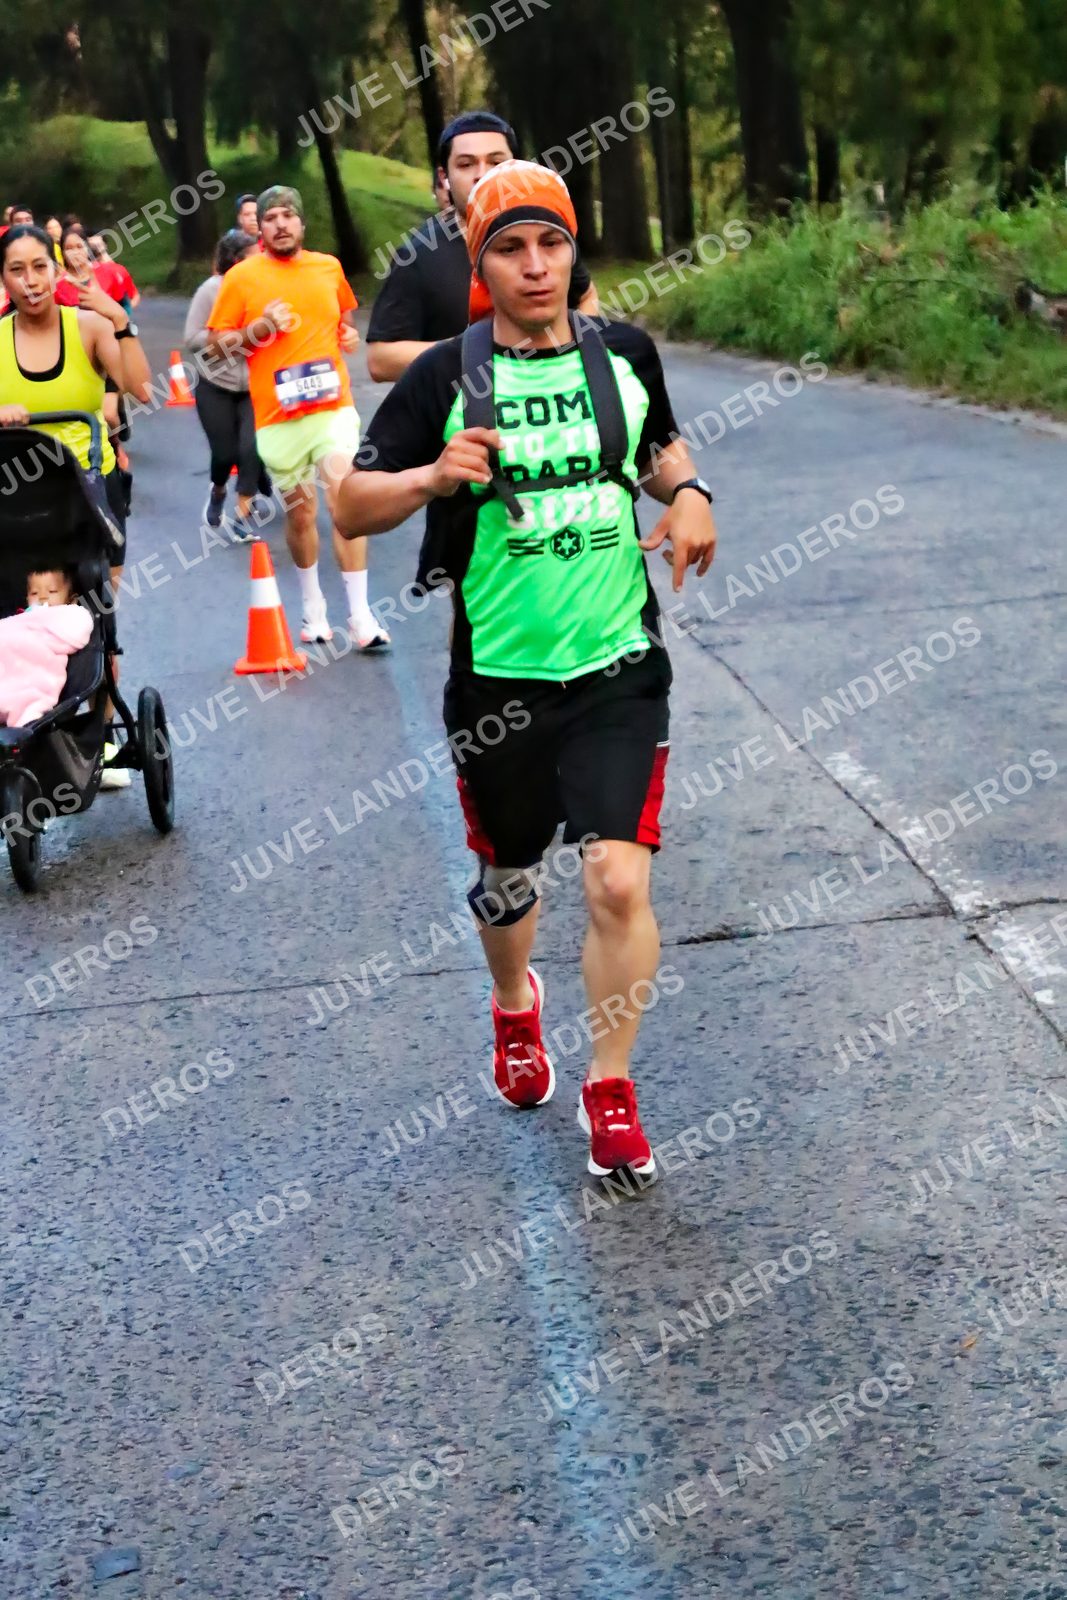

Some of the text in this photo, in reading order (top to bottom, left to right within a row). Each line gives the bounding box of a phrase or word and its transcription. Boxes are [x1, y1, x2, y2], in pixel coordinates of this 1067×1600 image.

[495, 390, 592, 429] COM
[499, 432, 544, 462] TO
[503, 454, 606, 489] DAR
